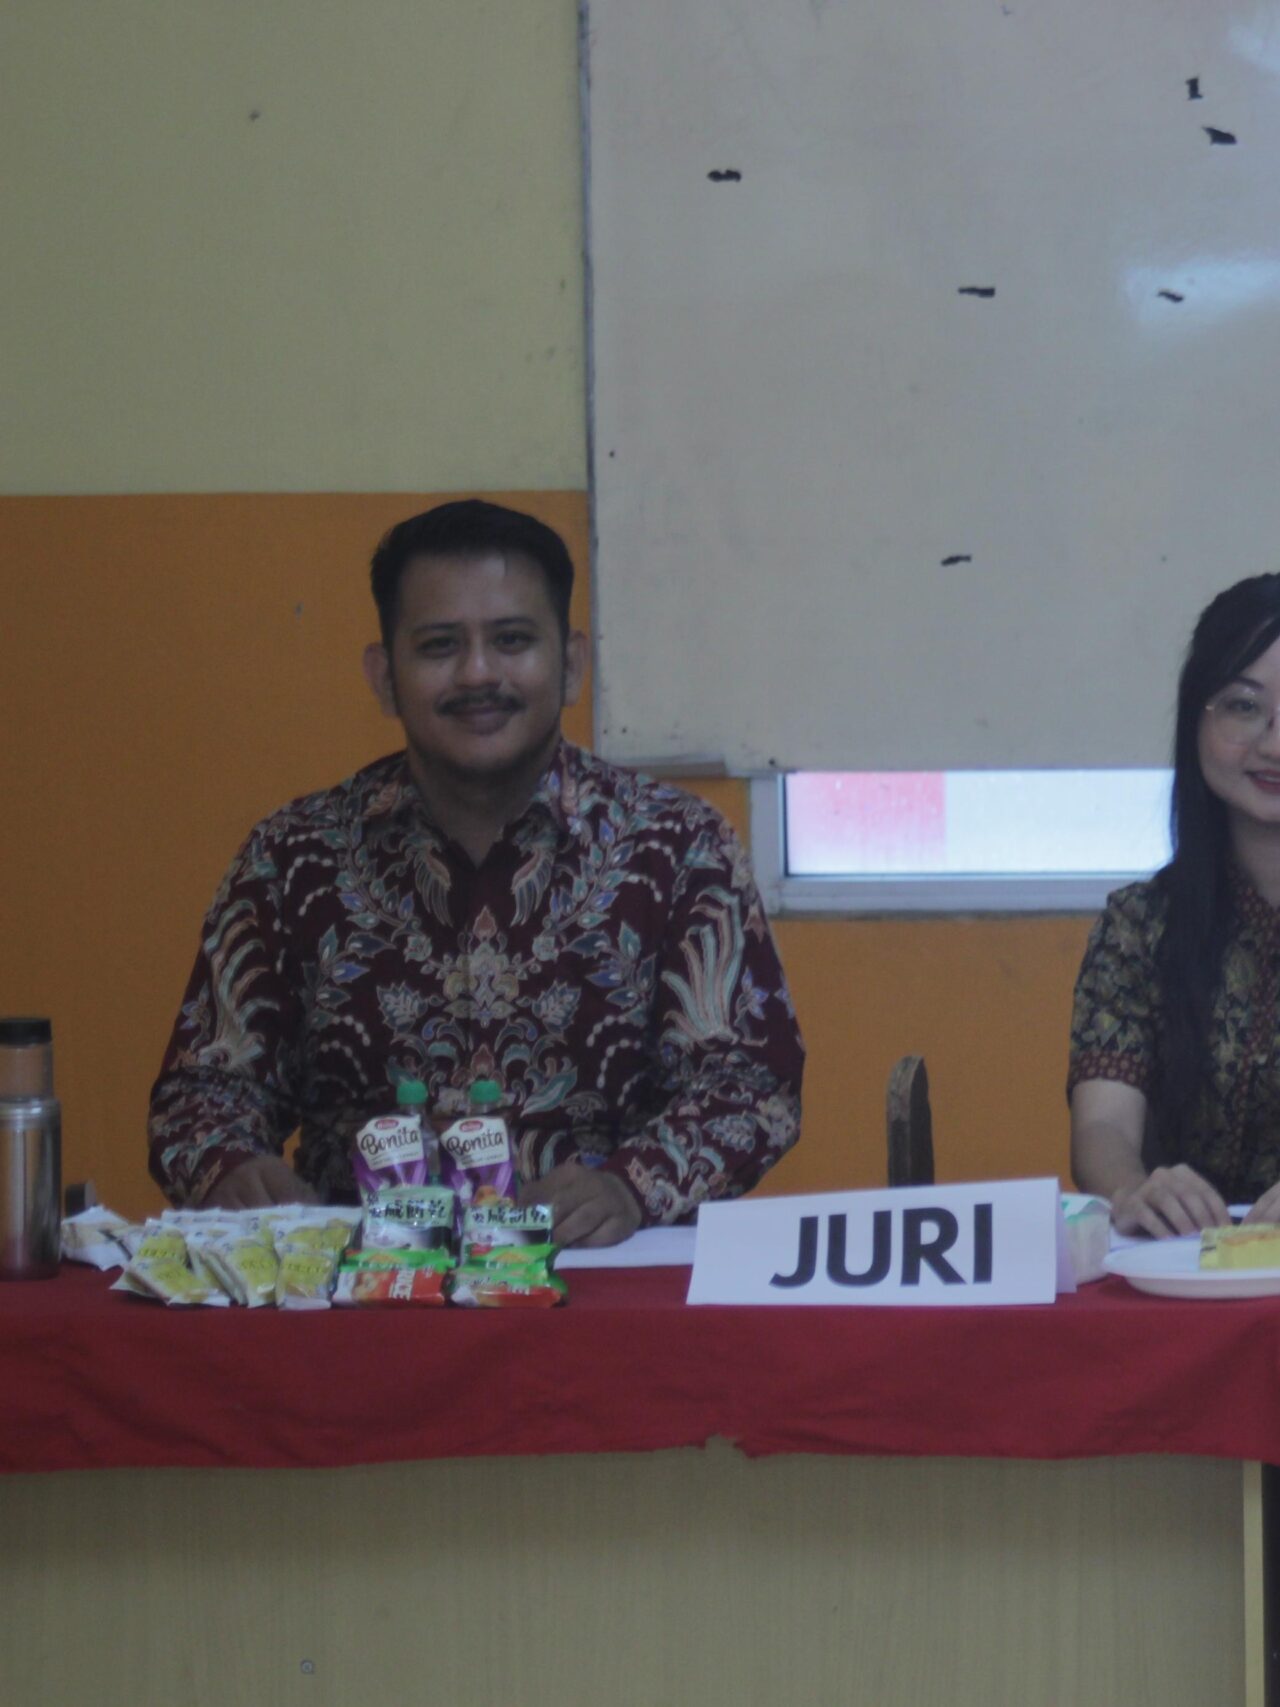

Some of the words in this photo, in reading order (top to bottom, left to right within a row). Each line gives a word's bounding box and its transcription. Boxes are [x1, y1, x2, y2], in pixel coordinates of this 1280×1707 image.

[360, 1127, 419, 1156] Bonita
[446, 1128, 504, 1156] Bonita
[769, 1202, 993, 1289] JURI
